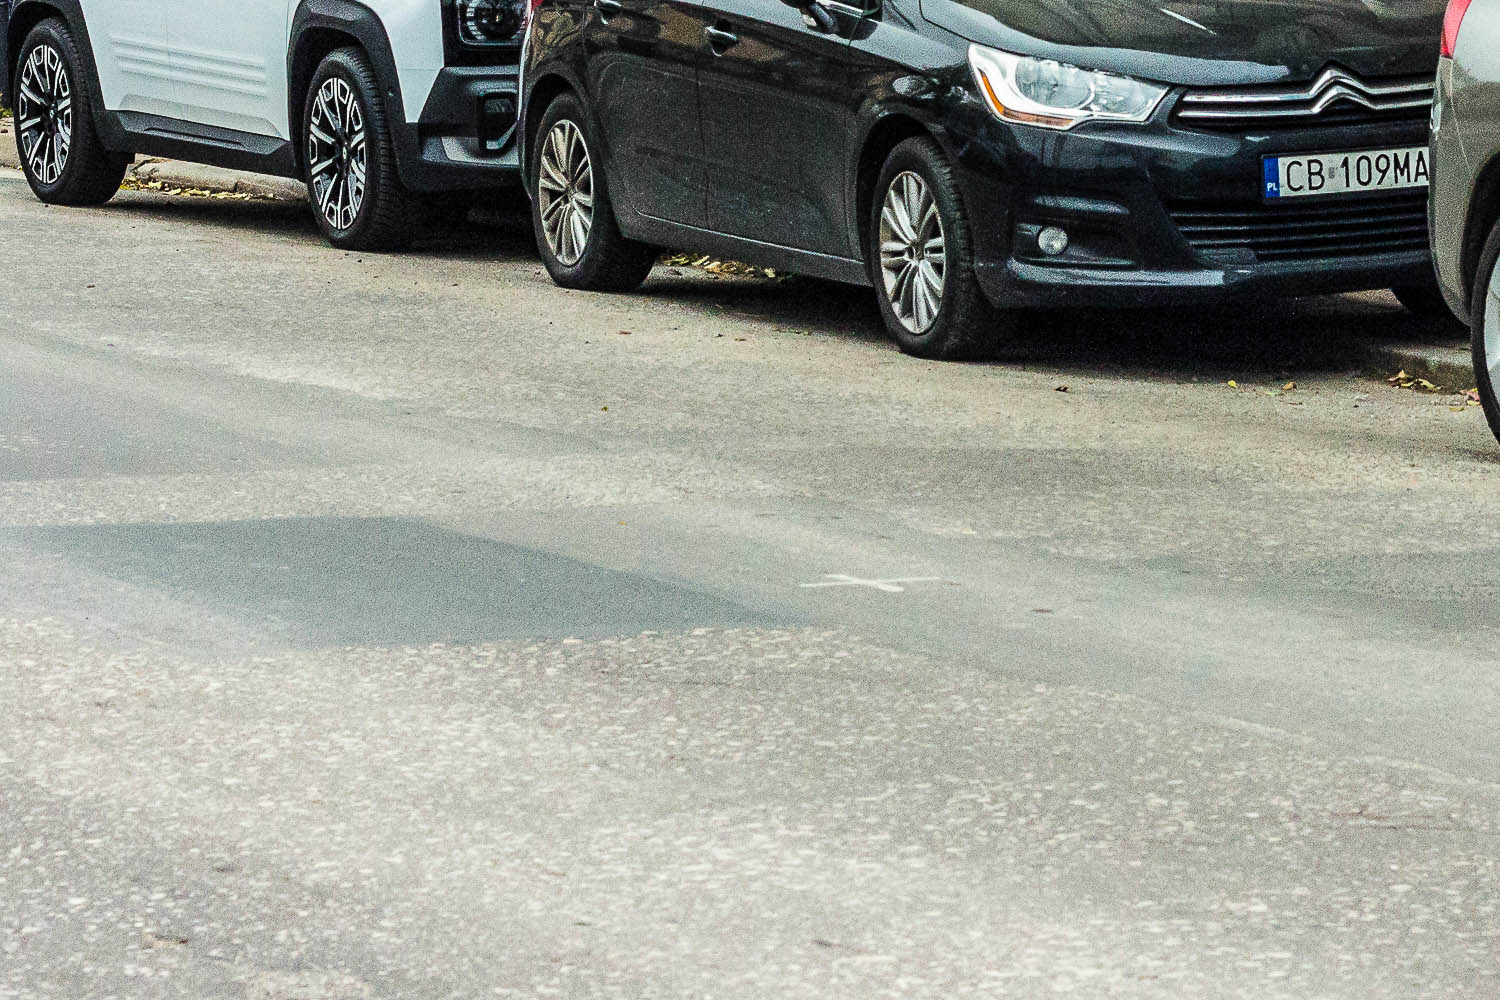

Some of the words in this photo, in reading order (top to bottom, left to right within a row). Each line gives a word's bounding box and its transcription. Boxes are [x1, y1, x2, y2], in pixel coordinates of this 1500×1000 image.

[1286, 158, 1326, 192] CB
[1339, 150, 1430, 188] 109MA
[1266, 182, 1278, 192] PL
